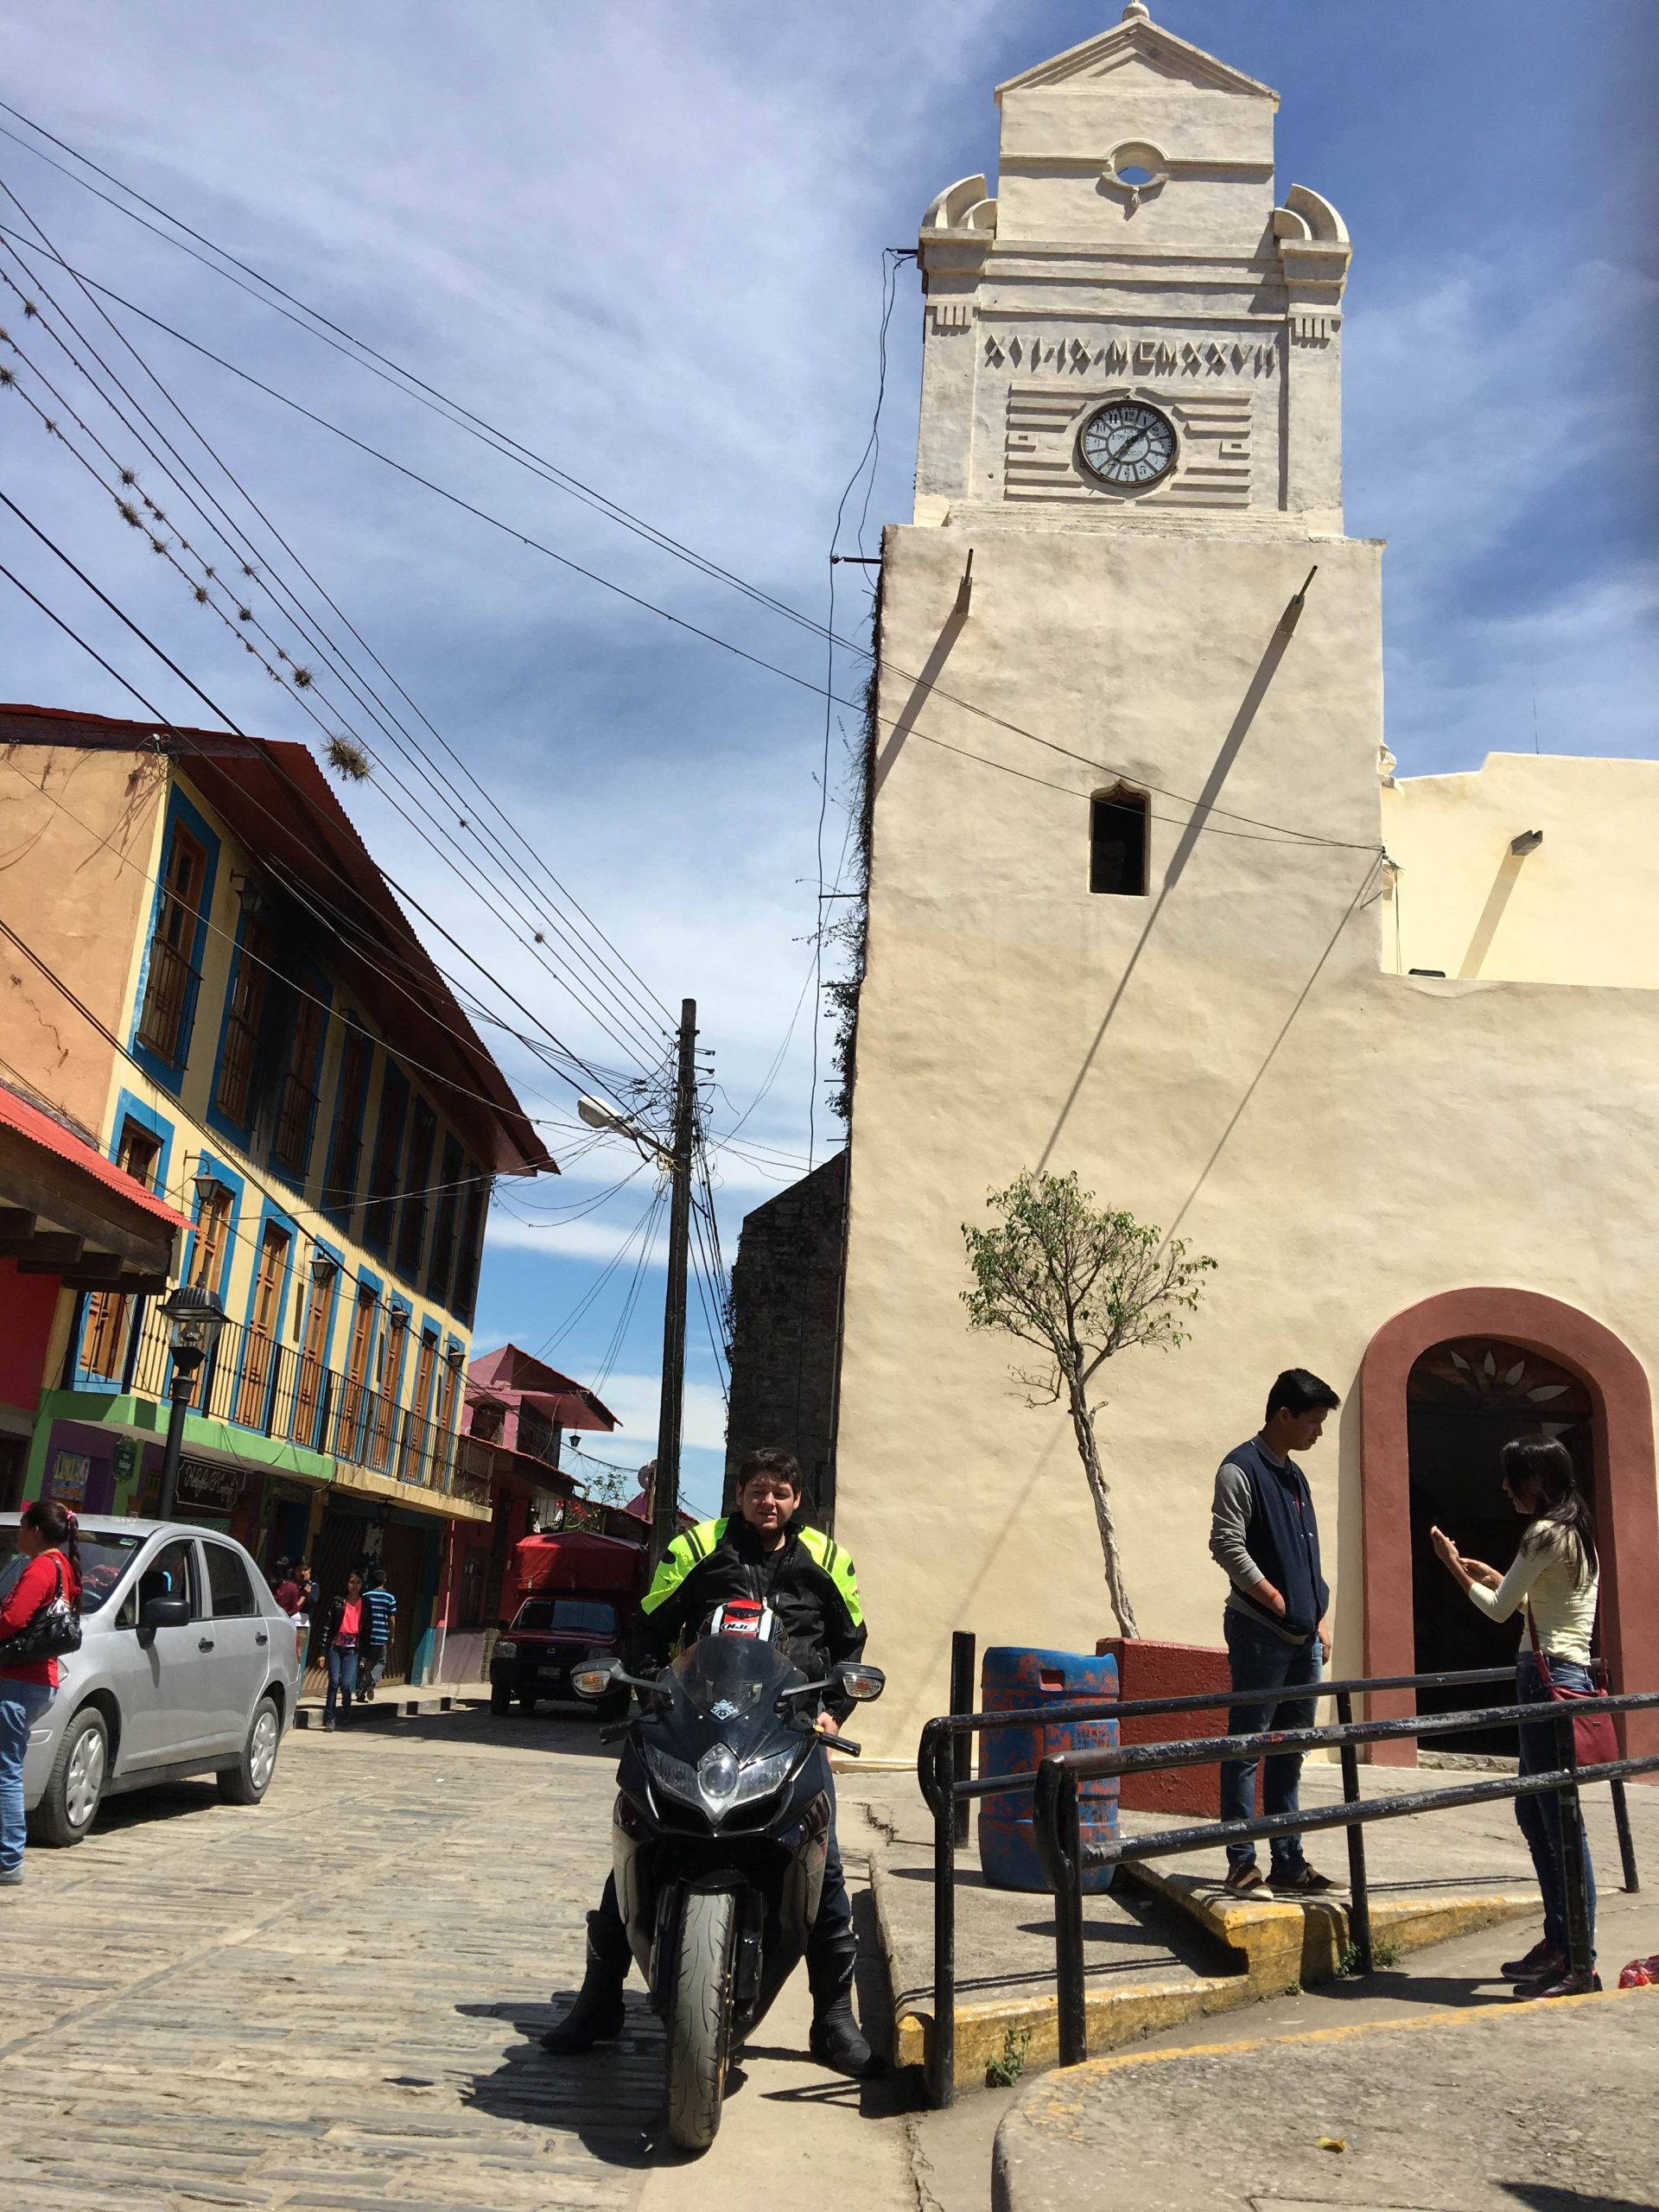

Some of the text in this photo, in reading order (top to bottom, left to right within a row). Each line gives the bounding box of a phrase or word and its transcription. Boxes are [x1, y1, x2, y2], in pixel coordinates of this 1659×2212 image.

[1109, 414, 1118, 424] 11
[1124, 410, 1135, 422] 12
[1142, 416, 1147, 427] 1
[1096, 423, 1106, 434] 10
[1152, 426, 1160, 436] 2
[1139, 466, 1147, 475] 5
